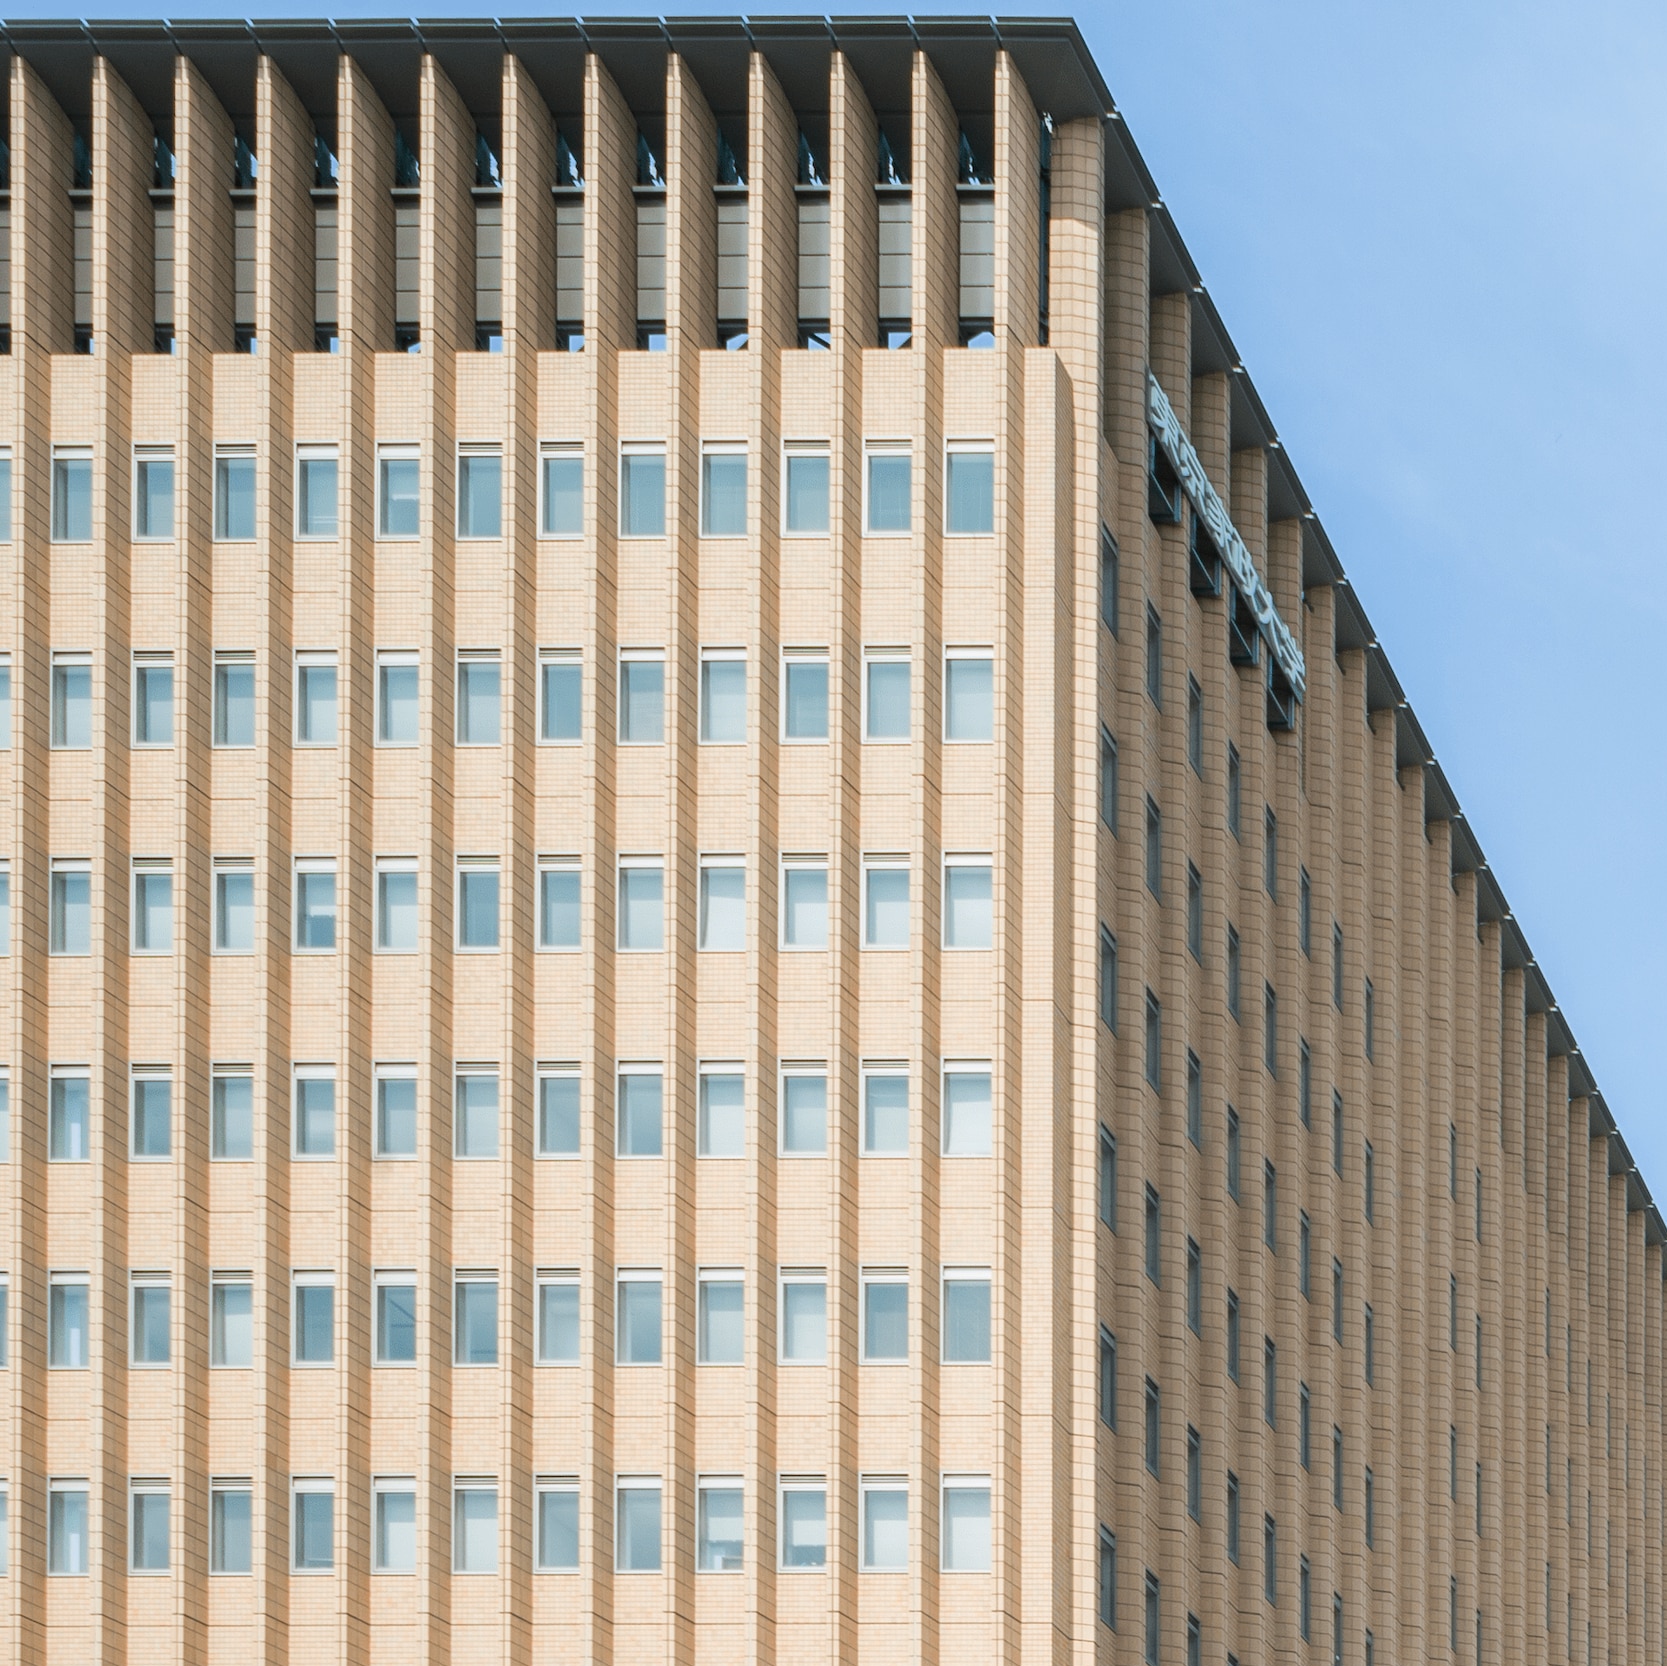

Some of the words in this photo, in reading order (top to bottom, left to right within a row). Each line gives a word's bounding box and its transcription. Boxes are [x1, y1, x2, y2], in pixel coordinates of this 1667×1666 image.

[1150, 373, 1306, 692] 東京家政大学
